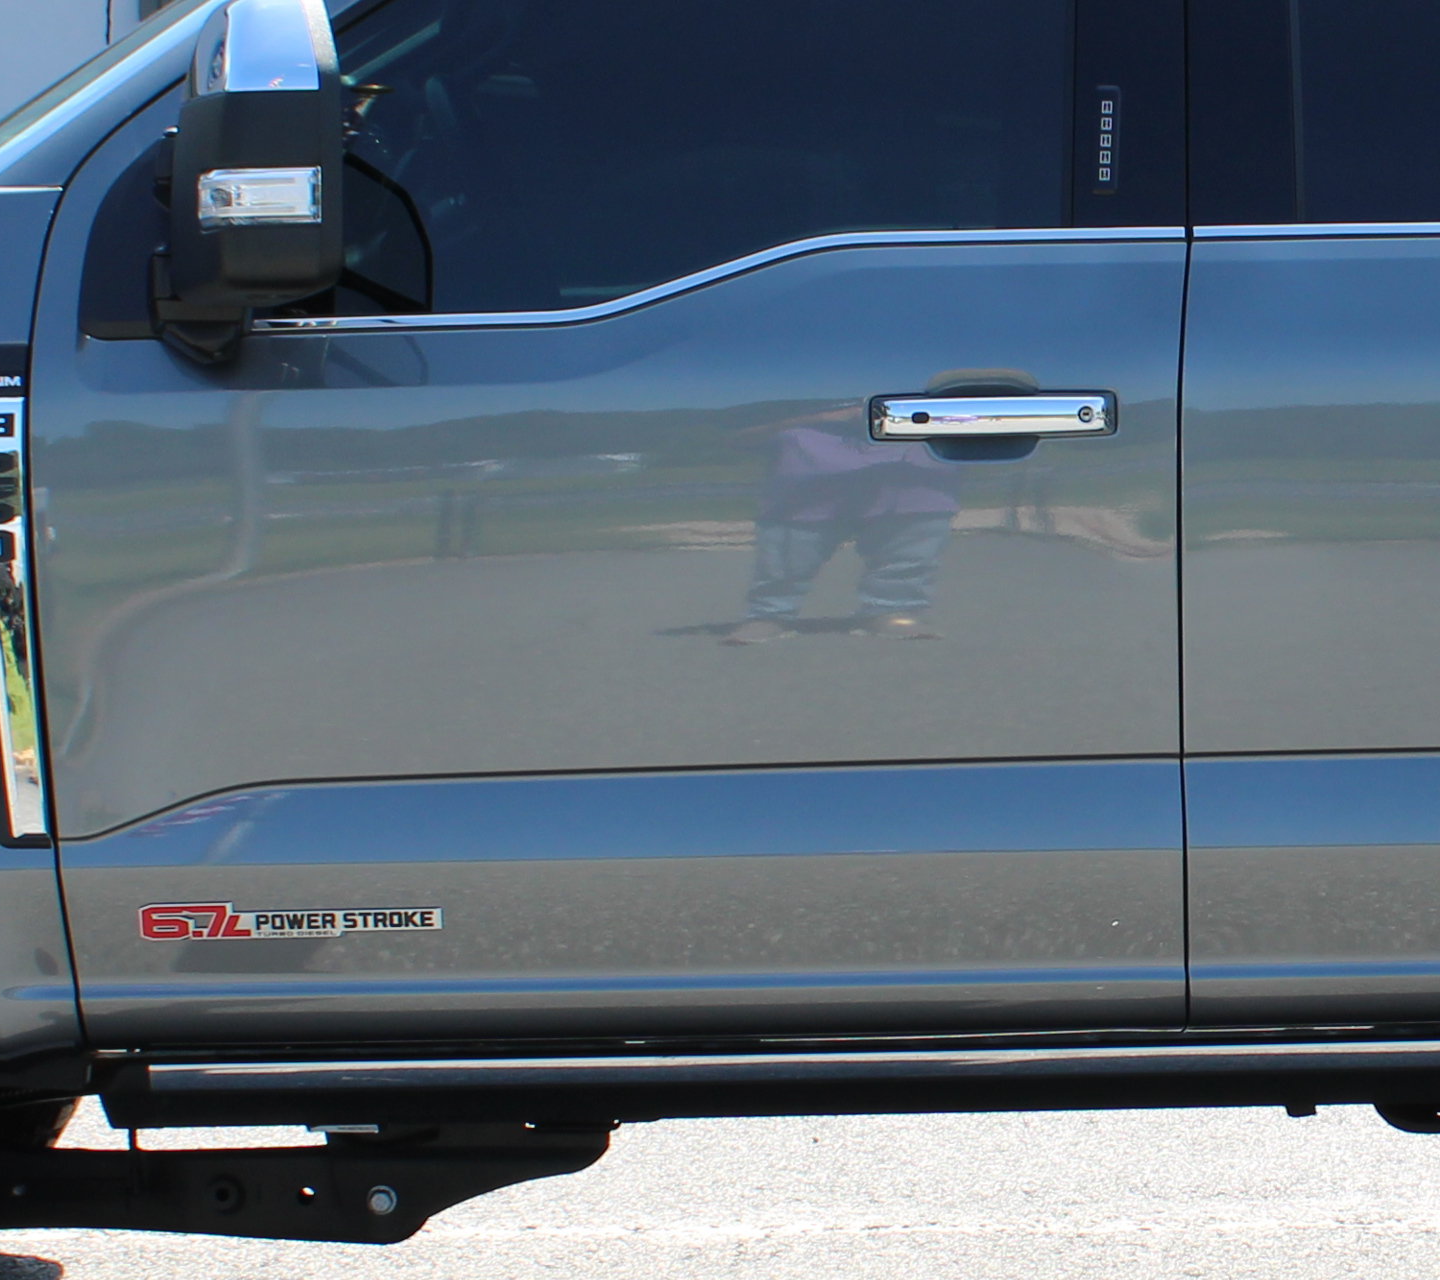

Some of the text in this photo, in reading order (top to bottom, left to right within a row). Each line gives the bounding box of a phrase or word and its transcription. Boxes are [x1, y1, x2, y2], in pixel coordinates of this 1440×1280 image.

[141, 905, 435, 938] 6.7L POWER STROKE
